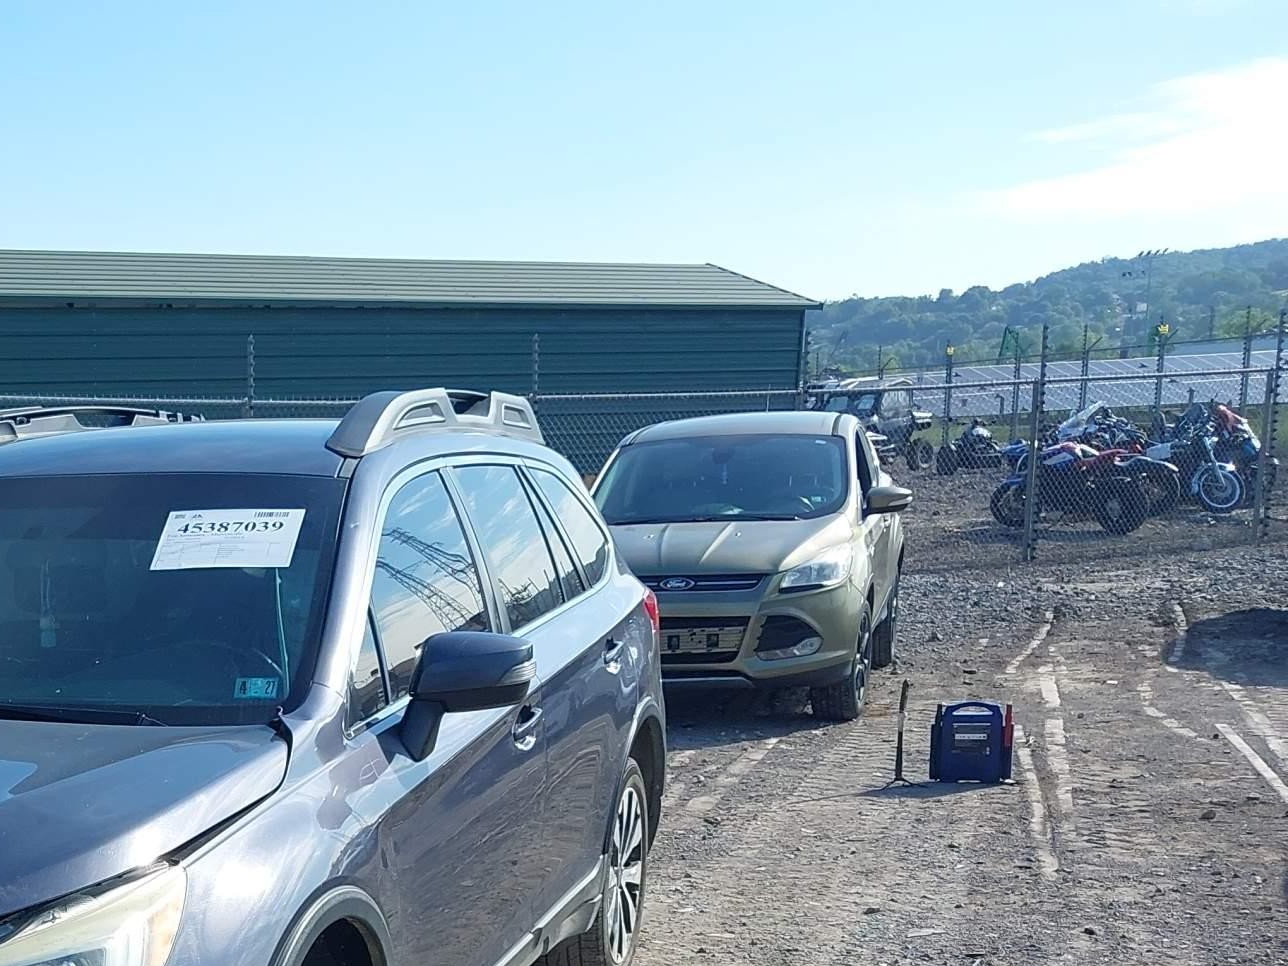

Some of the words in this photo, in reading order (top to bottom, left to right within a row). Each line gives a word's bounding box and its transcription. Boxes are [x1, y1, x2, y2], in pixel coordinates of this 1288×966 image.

[177, 521, 285, 534] 45387039
[239, 680, 248, 695] 4
[264, 680, 276, 695] 27
